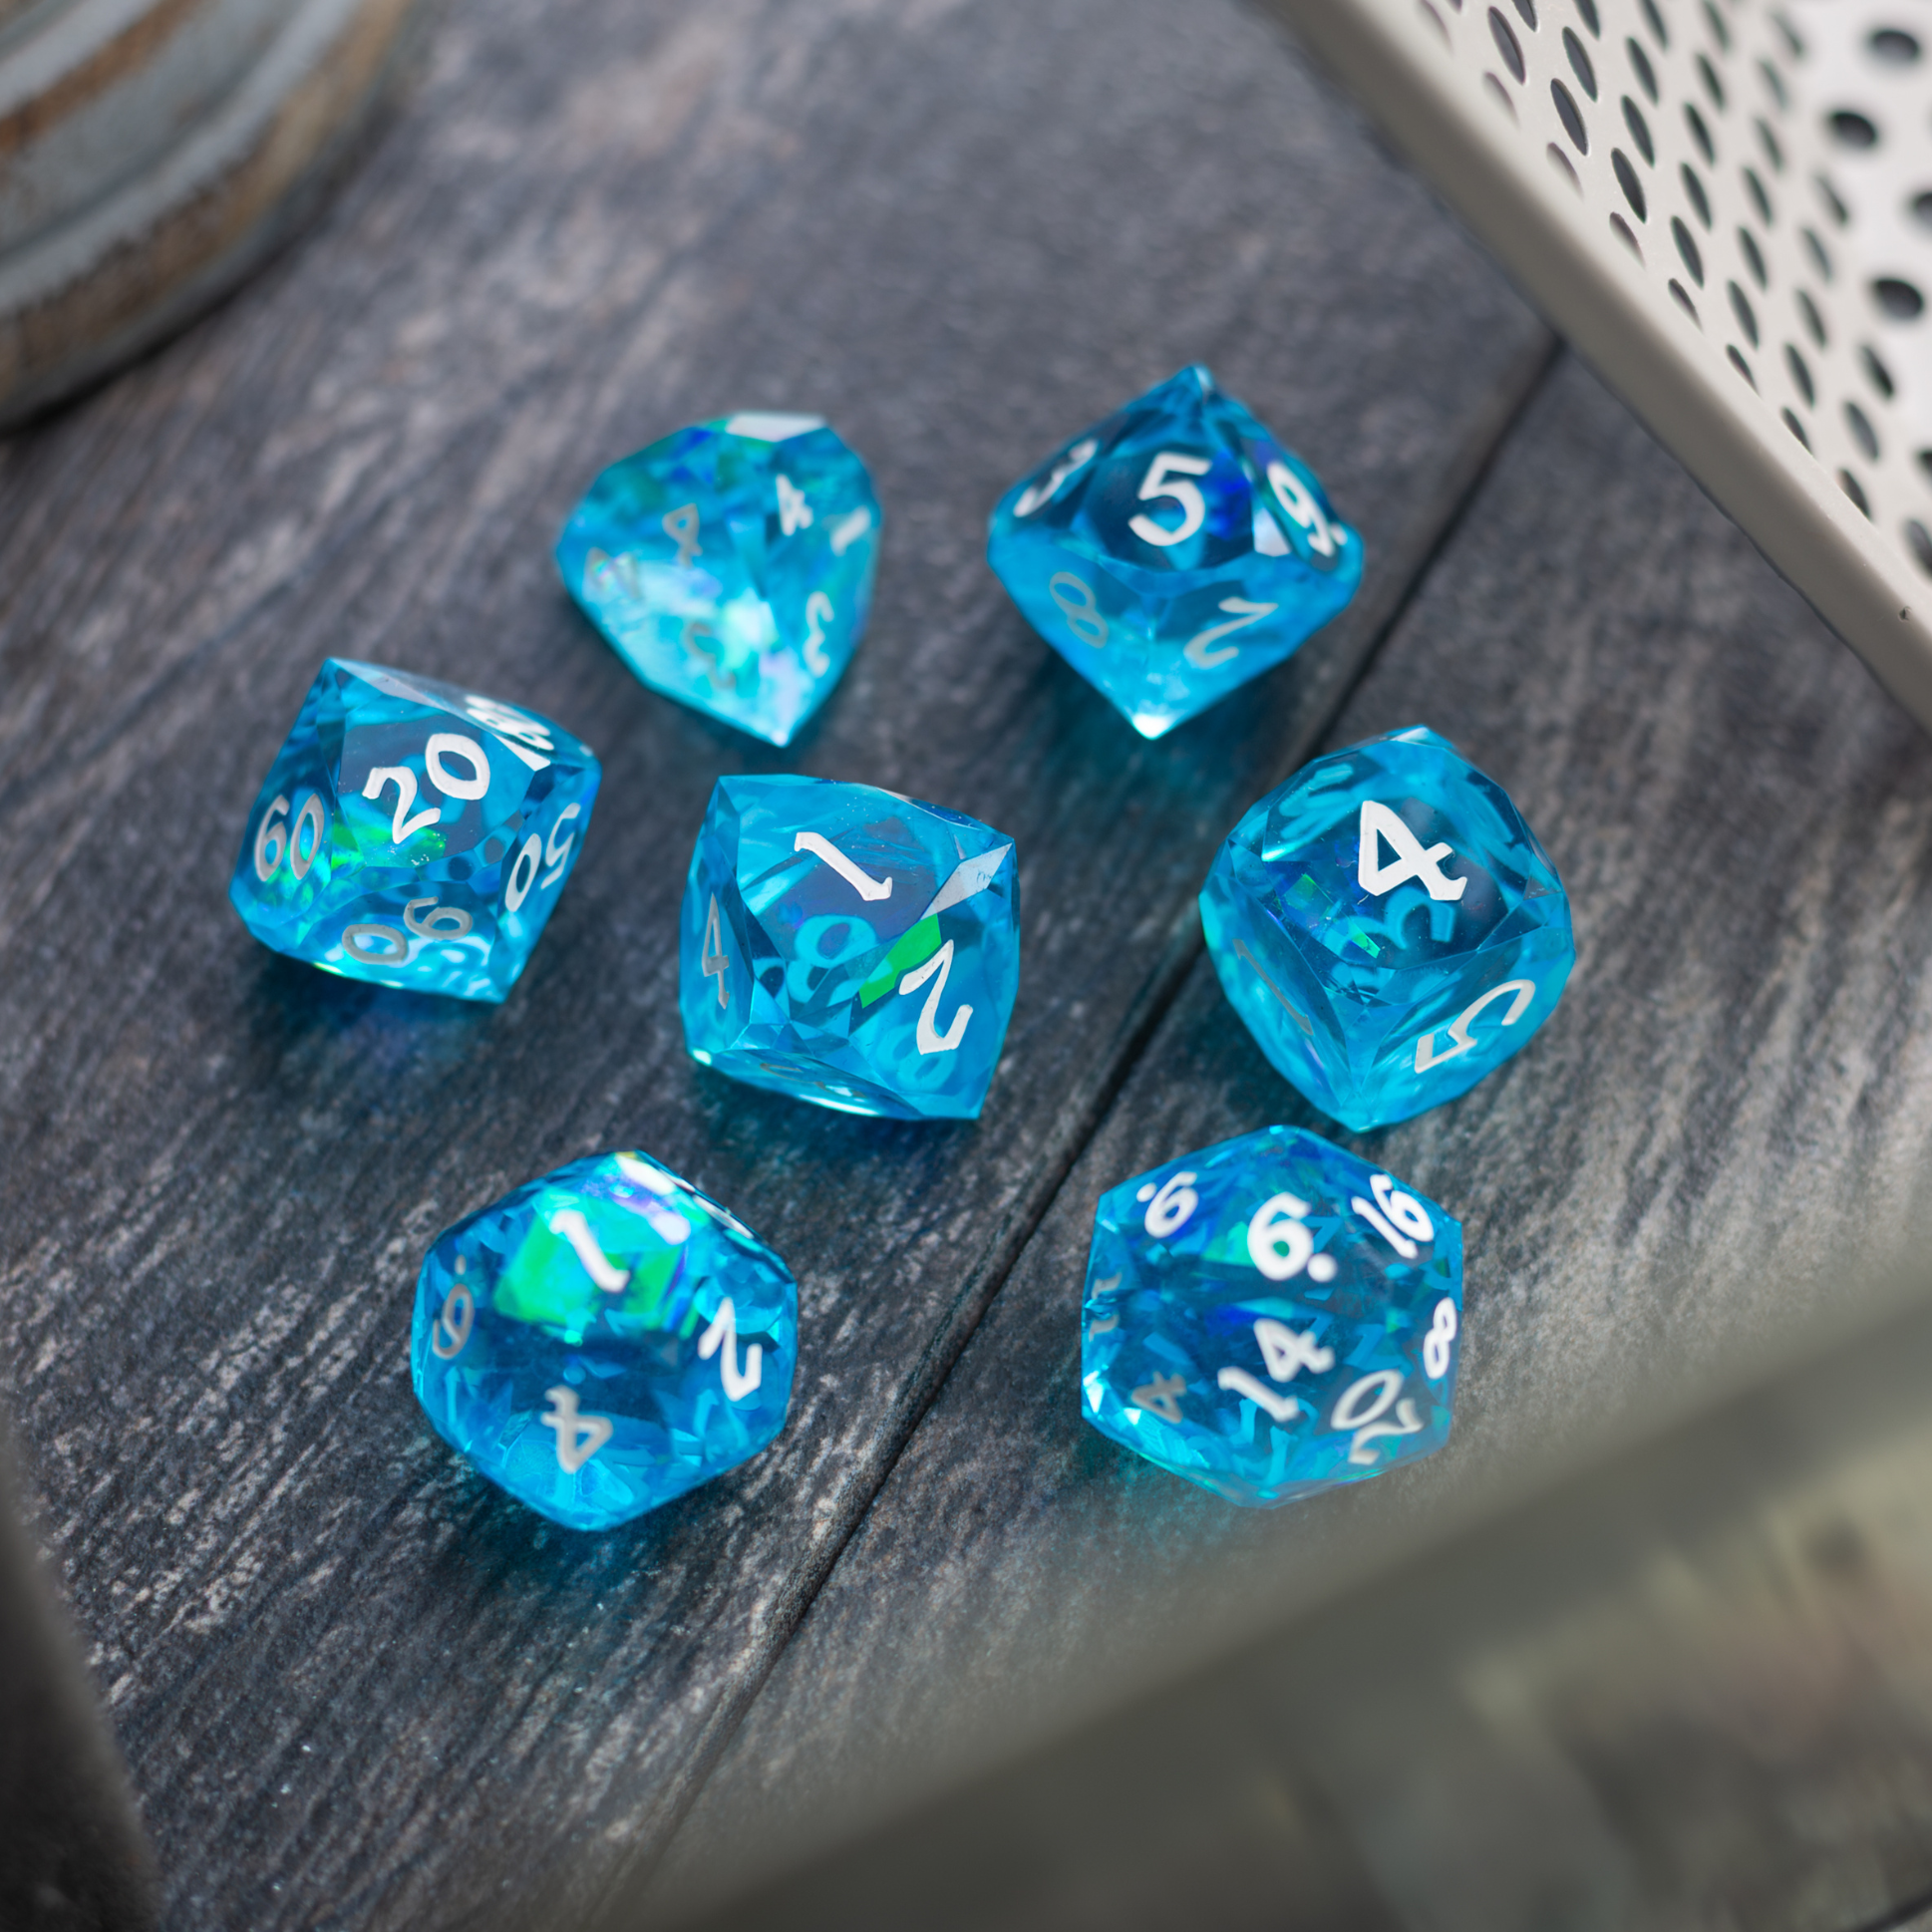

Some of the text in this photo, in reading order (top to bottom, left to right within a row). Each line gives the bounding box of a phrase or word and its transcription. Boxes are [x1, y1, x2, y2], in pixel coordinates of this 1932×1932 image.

[776, 473, 814, 536] 4
[1127, 451, 1213, 547] 5
[1049, 571, 1109, 650] 8
[1183, 596, 1279, 671] 2
[362, 732, 490, 845] 20
[253, 793, 325, 882] 60
[504, 802, 582, 913] 50
[794, 830, 893, 902] 1
[1358, 800, 1468, 902] 4
[701, 891, 730, 1010] 4
[898, 938, 974, 1056] 2
[1231, 937, 1315, 1037] 1
[1414, 978, 1537, 1075] 5
[549, 1208, 631, 1293] 1
[1350, 1172, 1436, 1260] 16
[697, 1296, 763, 1403] 2
[1216, 1317, 1337, 1424] 14
[1422, 1297, 1458, 1380] 8
[539, 1383, 614, 1474] 4
[1130, 1371, 1188, 1425] 4
[1330, 1368, 1425, 1465] 20
